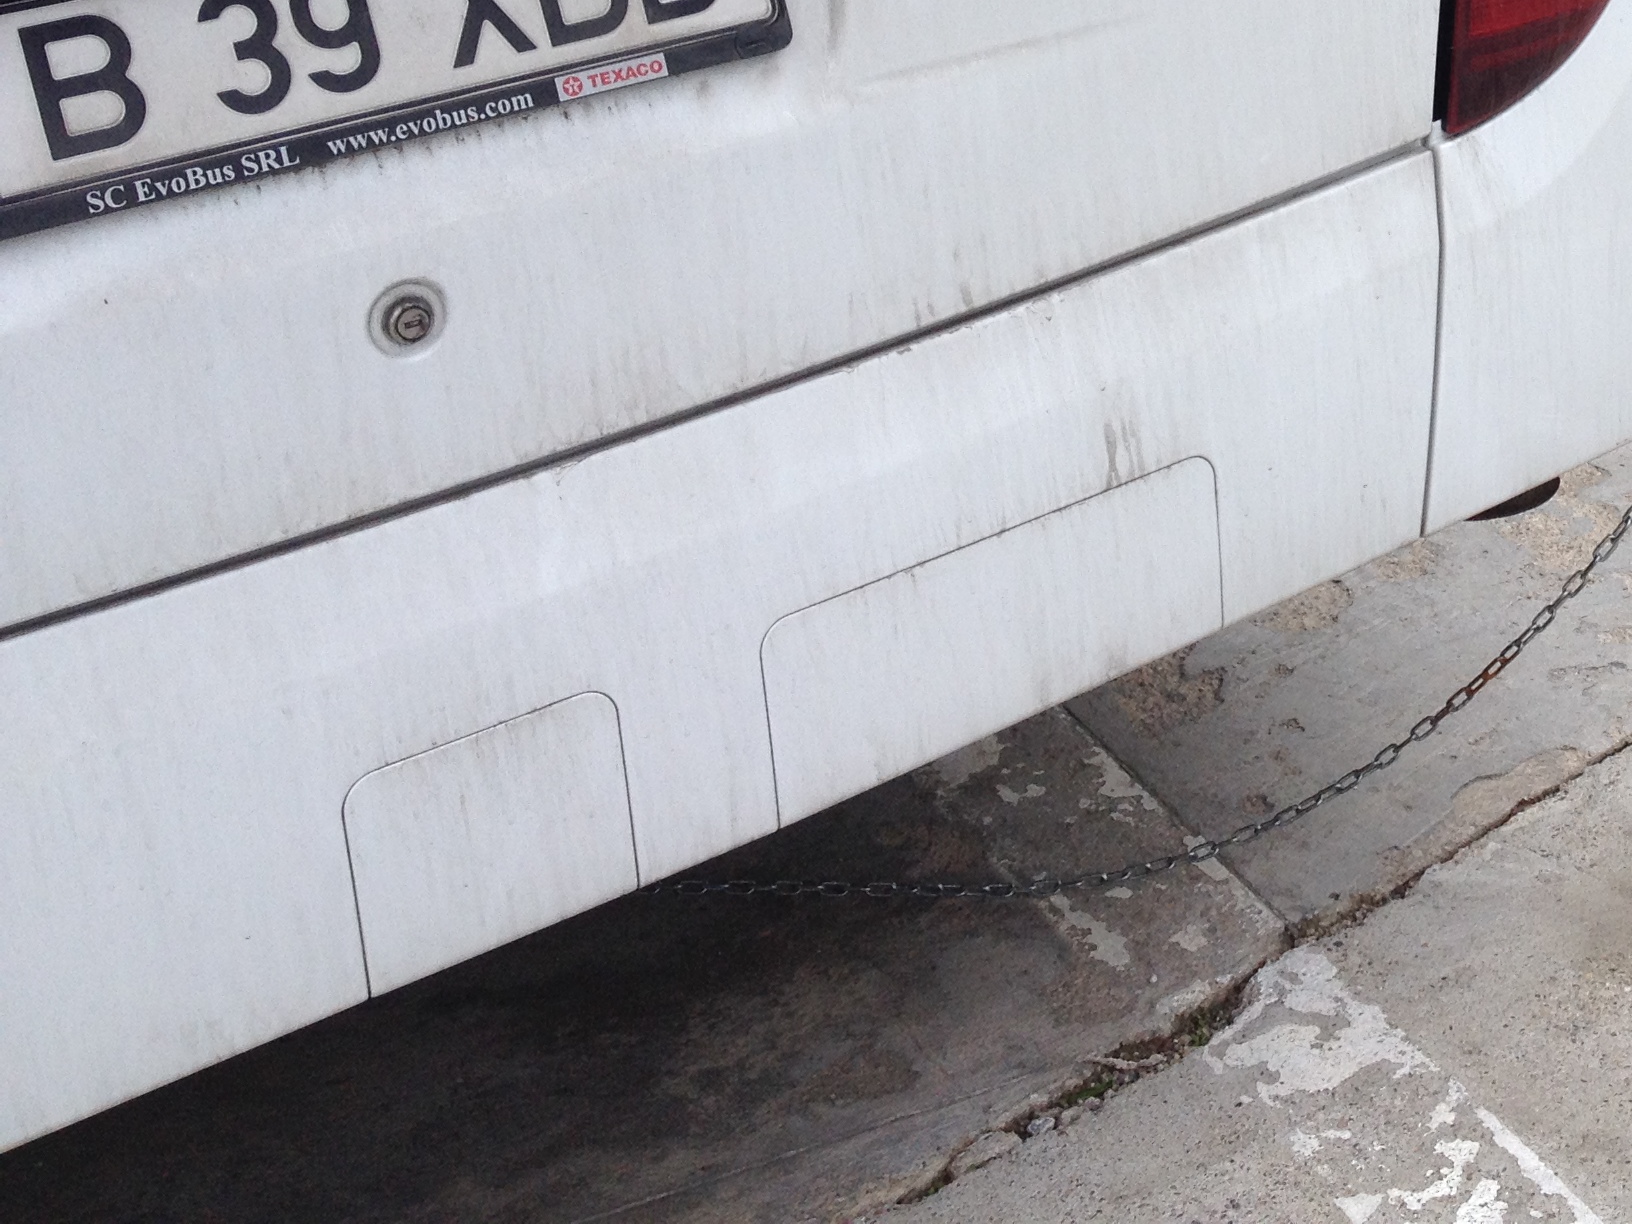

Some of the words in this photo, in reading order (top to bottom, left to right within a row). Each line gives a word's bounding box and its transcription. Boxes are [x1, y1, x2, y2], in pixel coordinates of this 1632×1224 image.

[17, 14, 147, 162] B
[587, 59, 664, 89] TEXACO
[86, 184, 127, 214] SC
[133, 167, 235, 203] EvoBus
[240, 145, 300, 177] SRL
[327, 93, 534, 156] www.evobus.com
